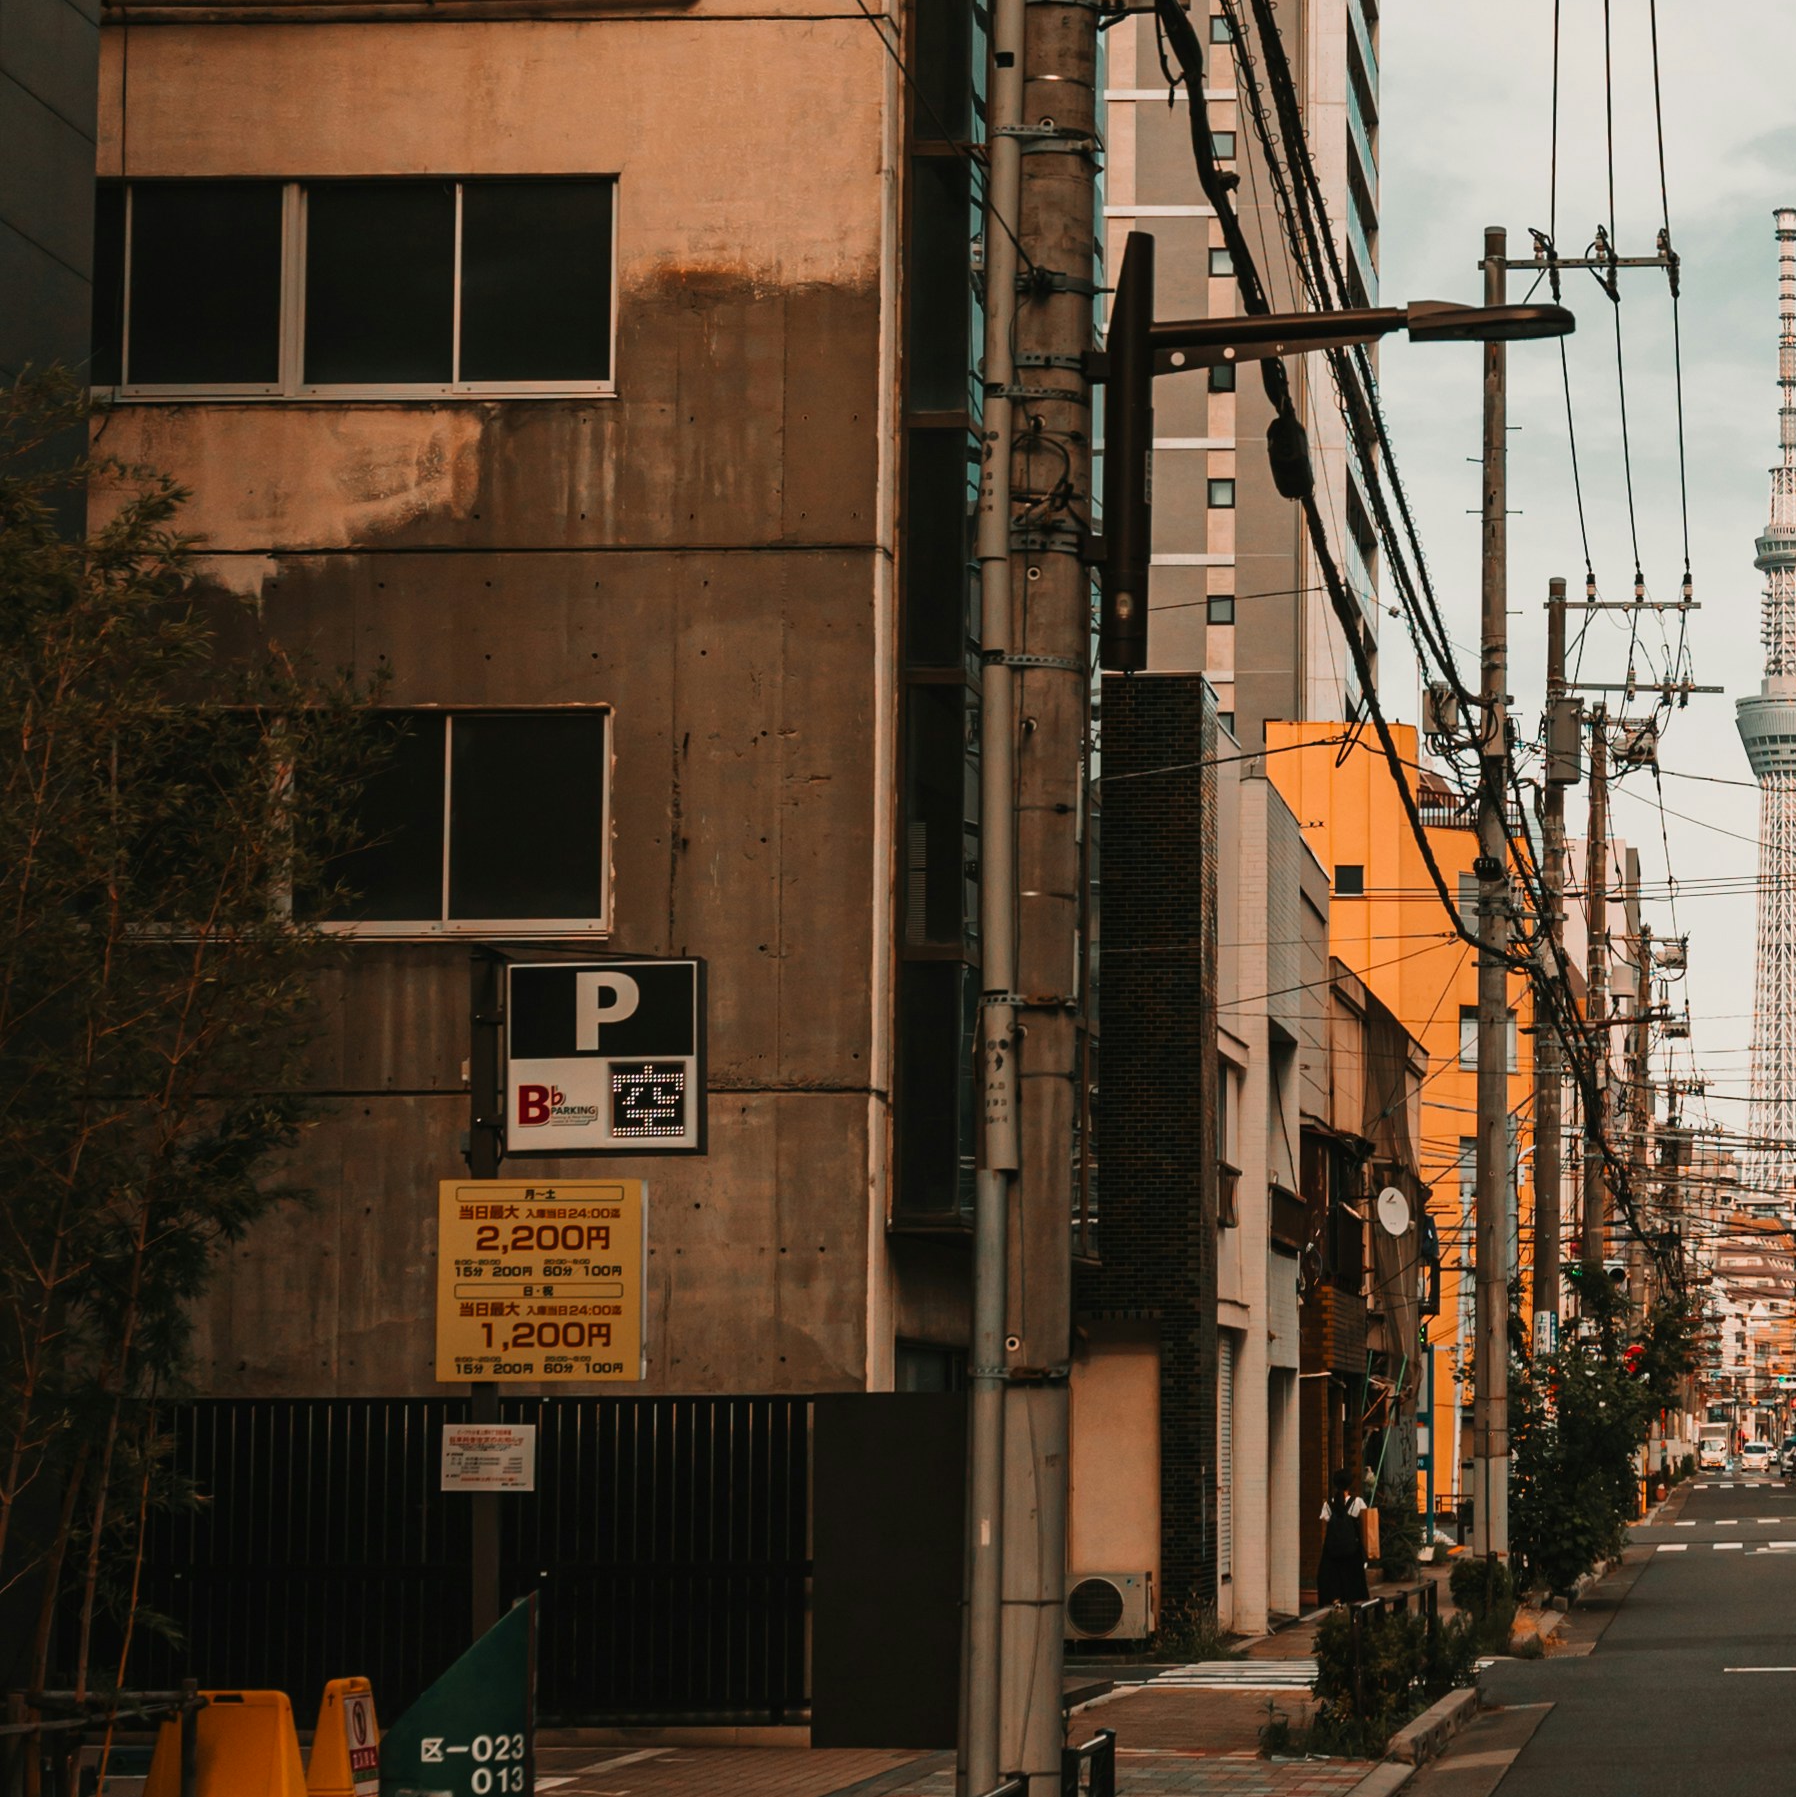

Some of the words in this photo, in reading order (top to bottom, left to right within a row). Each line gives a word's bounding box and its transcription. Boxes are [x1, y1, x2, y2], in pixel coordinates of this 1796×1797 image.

[575, 971, 640, 1051] P
[551, 1105, 596, 1115] PARKING
[612, 1064, 685, 1137] 空
[459, 1205, 519, 1220] 当日最大
[476, 1225, 610, 1254] 2,200円
[459, 1302, 520, 1317] 当日最大
[481, 1322, 611, 1352] 1,200円
[471, 1766, 524, 1795] 013
